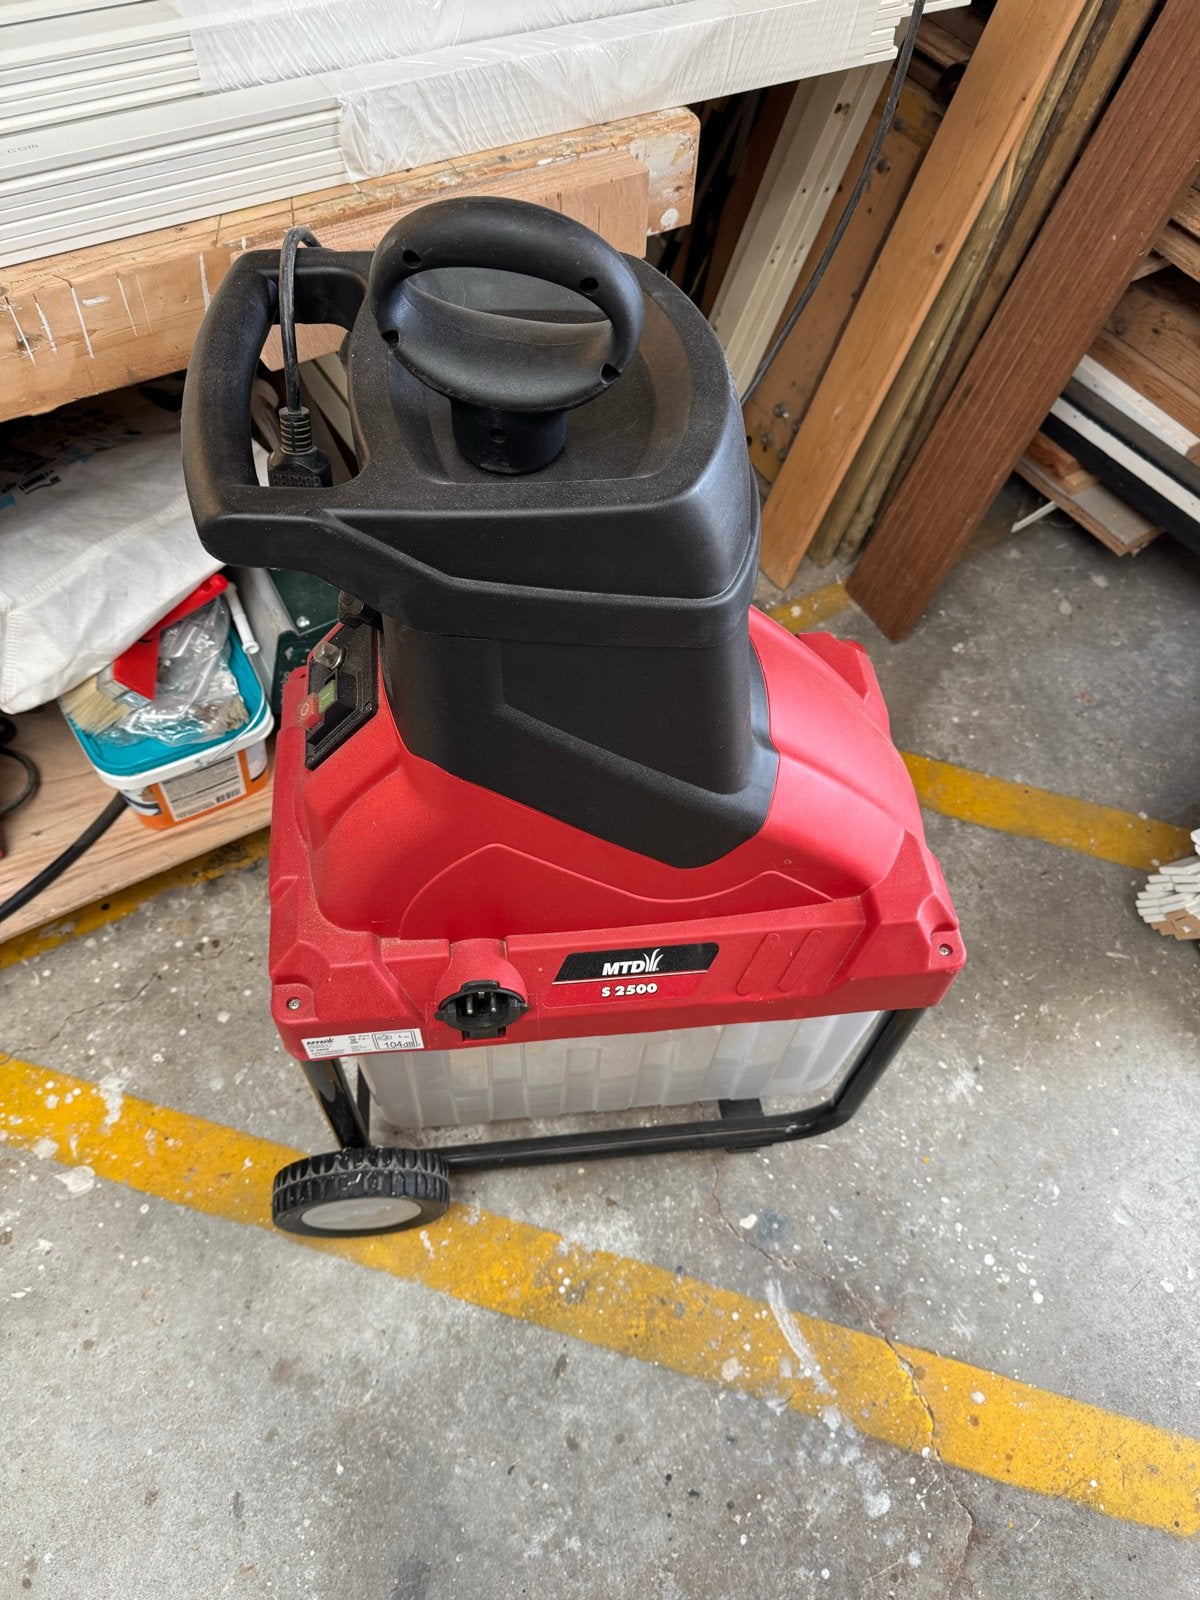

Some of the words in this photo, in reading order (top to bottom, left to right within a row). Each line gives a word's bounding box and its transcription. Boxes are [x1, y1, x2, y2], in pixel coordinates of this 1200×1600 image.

[602, 960, 646, 976] MTD
[601, 986, 611, 997] S
[614, 983, 658, 996] 2500
